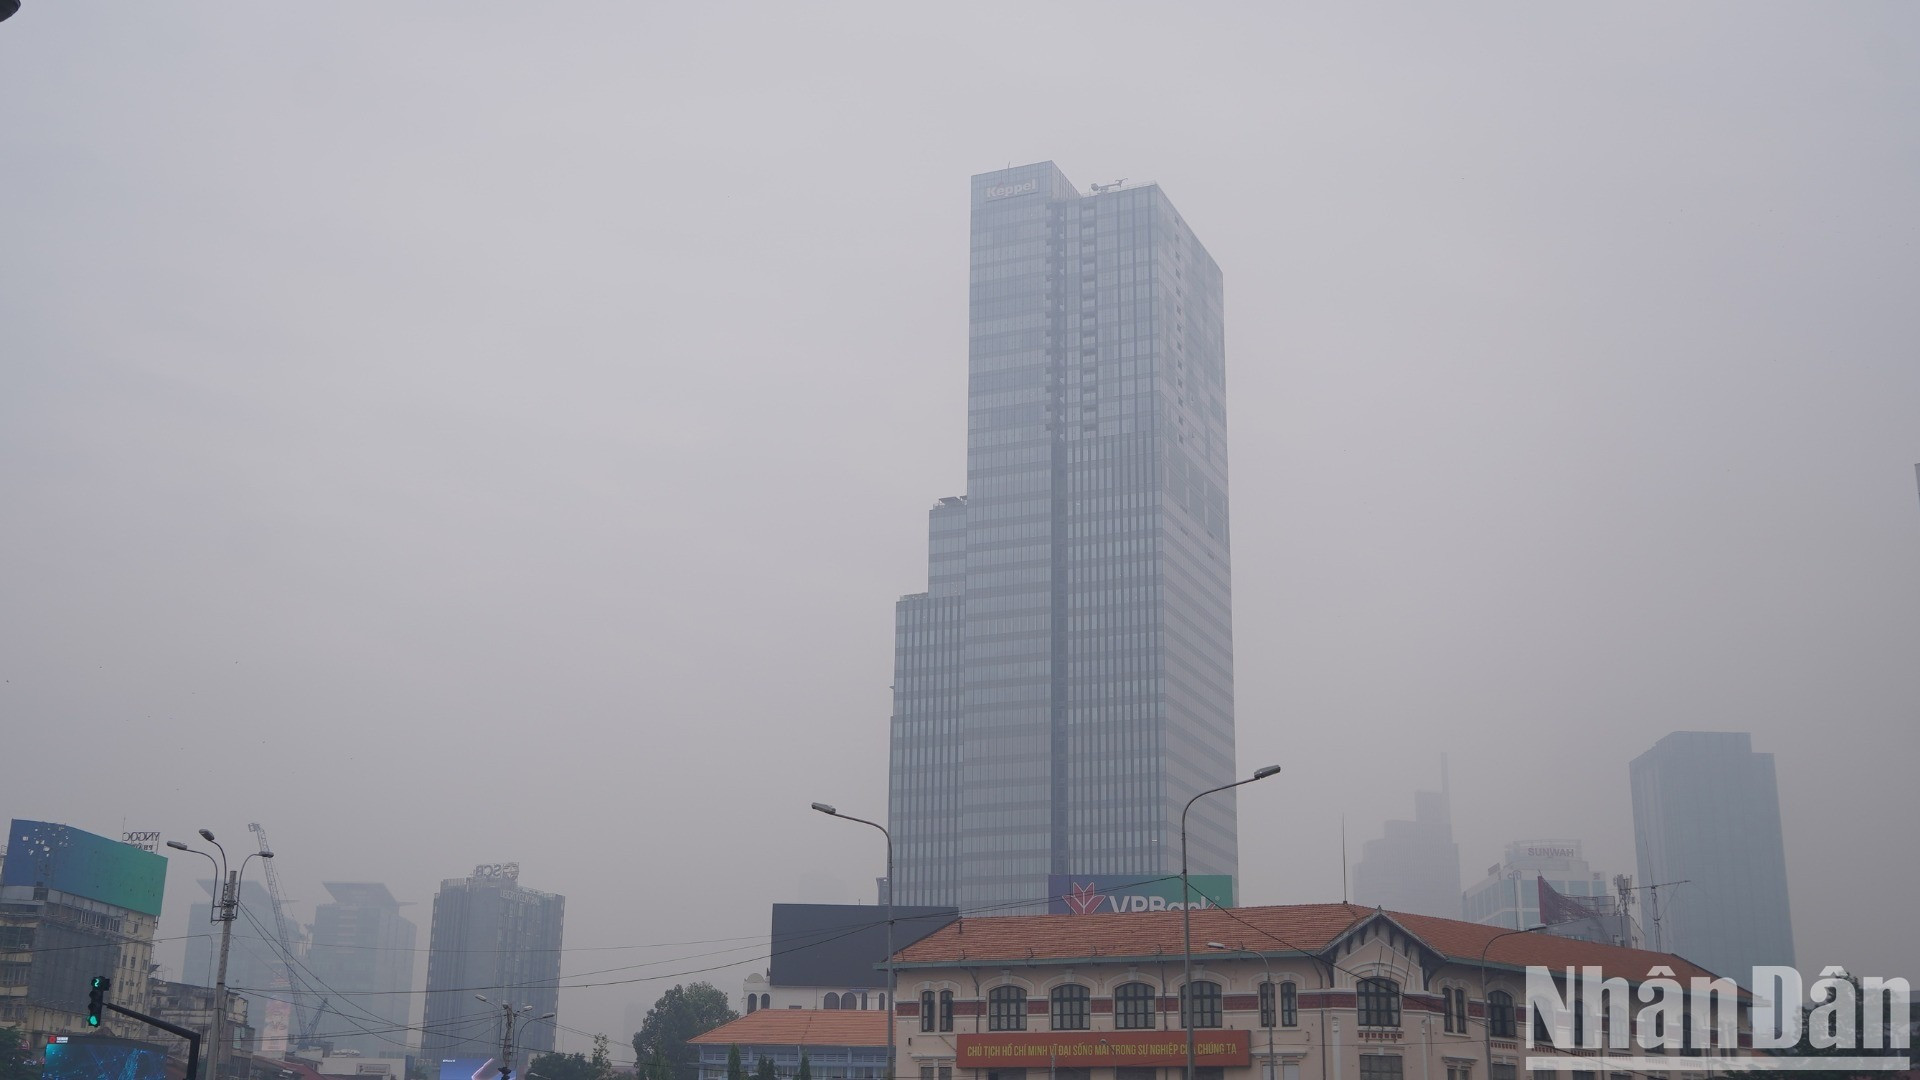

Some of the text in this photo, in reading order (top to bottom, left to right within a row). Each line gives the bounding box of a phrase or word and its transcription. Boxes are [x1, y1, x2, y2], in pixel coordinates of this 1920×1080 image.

[986, 178, 1036, 198] Keppel
[1528, 847, 1574, 857] SUNWAH
[1109, 895, 1215, 913] VPBank
[983, 1045, 1001, 1058] TỊCH
[1014, 1042, 1027, 1056] CHÍ
[1028, 1045, 1048, 1056] MINH
[1058, 1045, 1072, 1058] ĐẠI
[1074, 1041, 1094, 1056] SỐNG
[1111, 1044, 1137, 1055] TRONG
[1138, 1043, 1149, 1057] SỰ
[1150, 1042, 1178, 1057] NGHIỆP
[1197, 1041, 1225, 1055] CHÚNG
[1226, 1043, 1237, 1055] TA
